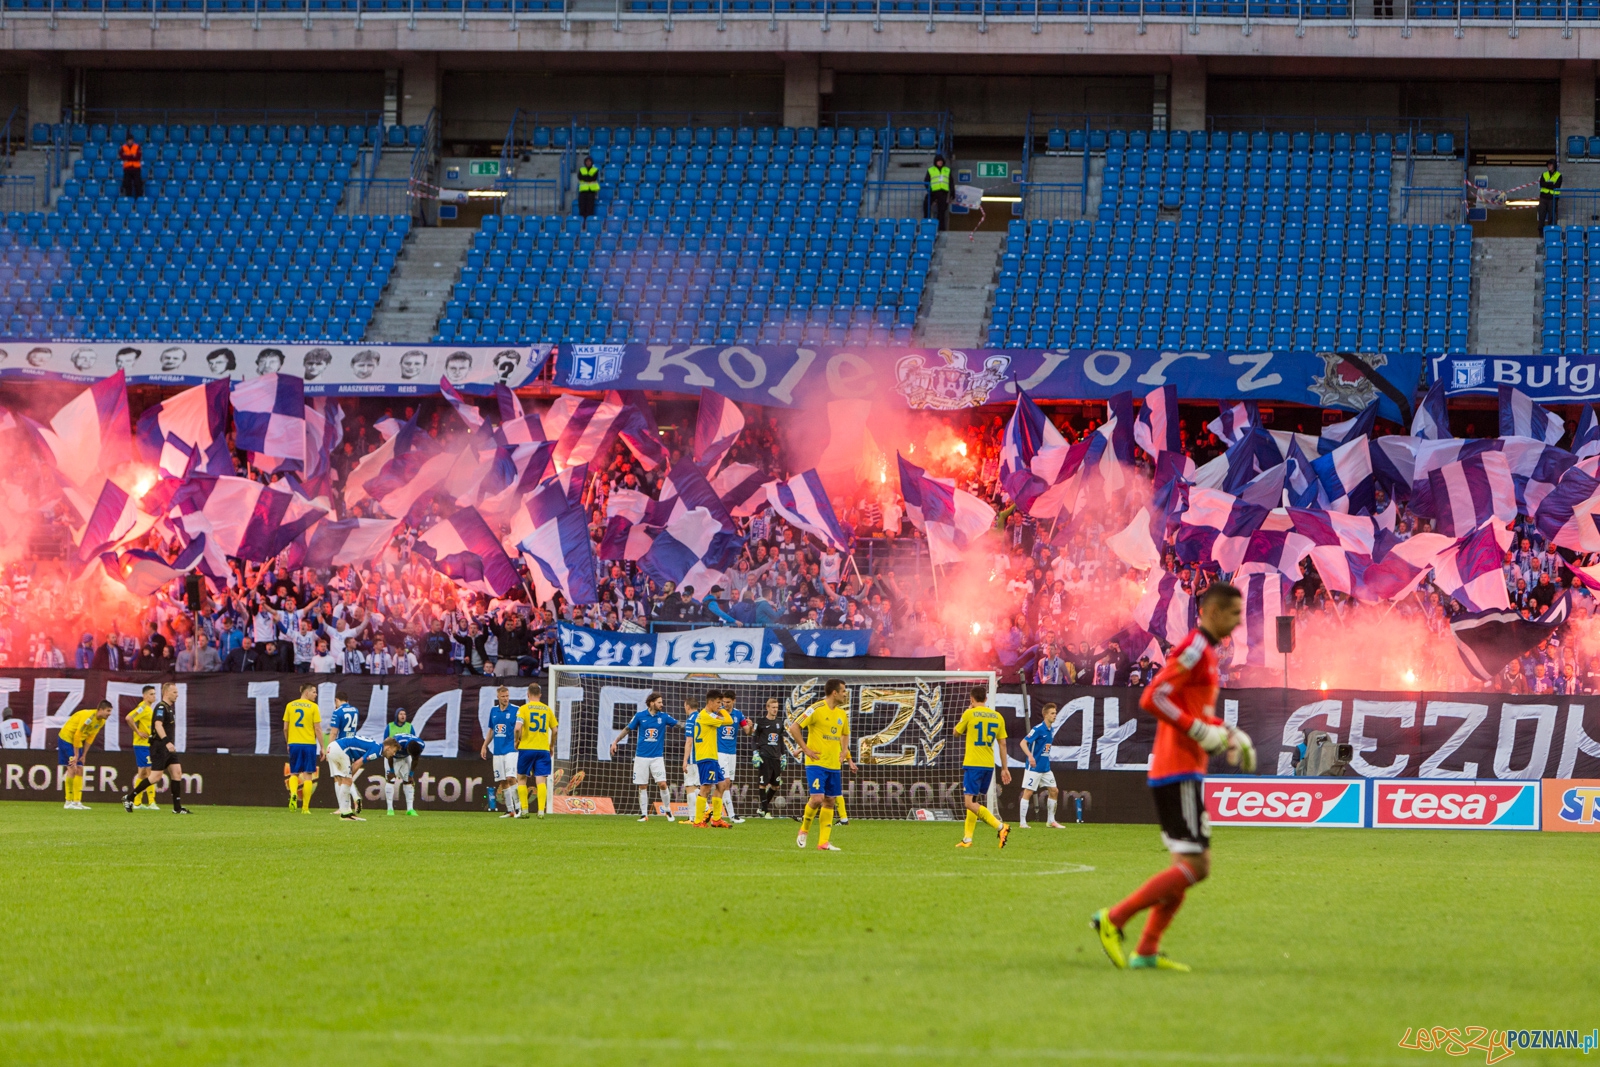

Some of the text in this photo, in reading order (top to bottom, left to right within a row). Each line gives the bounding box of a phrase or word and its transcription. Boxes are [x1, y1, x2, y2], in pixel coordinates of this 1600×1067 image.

[578, 344, 620, 353] KKS LECH
[1492, 355, 1600, 394] Bułg
[304, 385, 325, 393] KASIK
[338, 385, 386, 393] ARASZKIEWICZ
[294, 709, 305, 728] 2
[343, 713, 359, 732] 24
[528, 712, 548, 733] 51
[494, 724, 507, 733] STS
[644, 728, 659, 739] STS
[721, 726, 735, 736] STS
[973, 721, 999, 747] 15
[4, 731, 23, 742] FOTO
[767, 733, 779, 742] STS
[0, 764, 203, 795] ROKER.om
[812, 778, 821, 790] 4
[1027, 778, 1034, 787] 2
[1212, 786, 1313, 818] tesa
[1386, 788, 1489, 820] tesa
